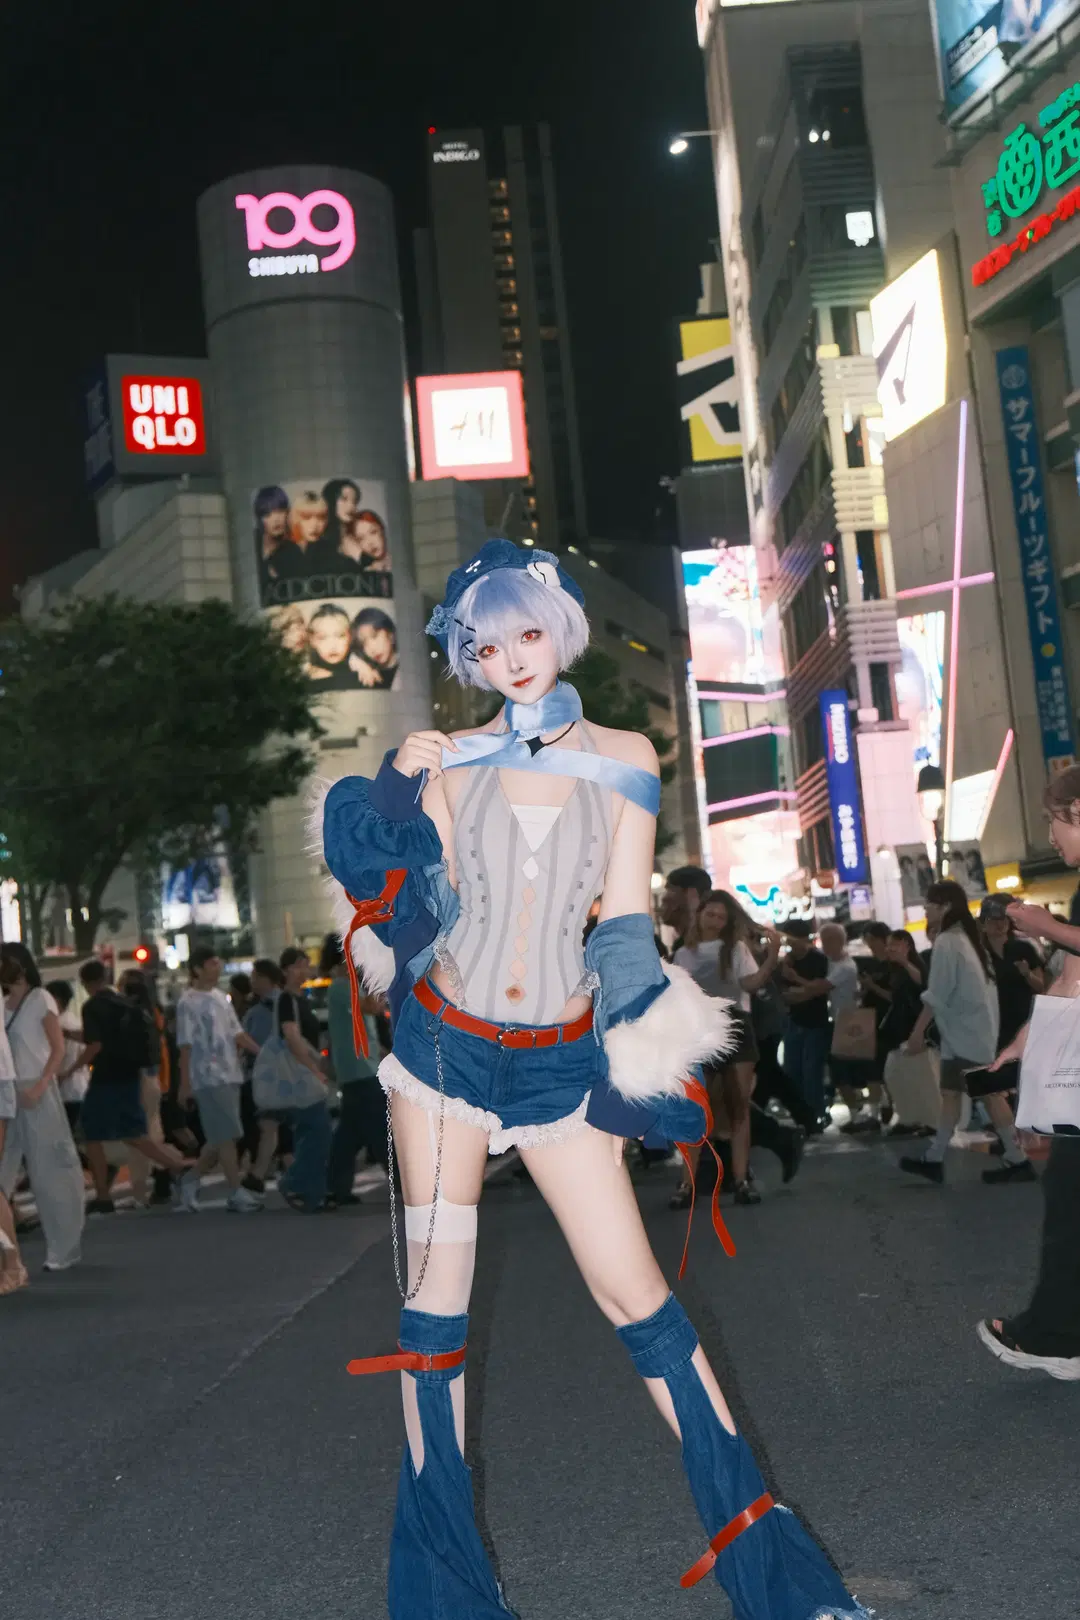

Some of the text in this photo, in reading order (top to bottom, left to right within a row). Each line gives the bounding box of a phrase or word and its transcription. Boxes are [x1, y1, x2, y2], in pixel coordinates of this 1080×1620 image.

[235, 189, 356, 272] 109
[129, 384, 189, 415] UNI
[132, 415, 197, 450] QLO
[1005, 396, 1053, 634] サマーフルーツギフト
